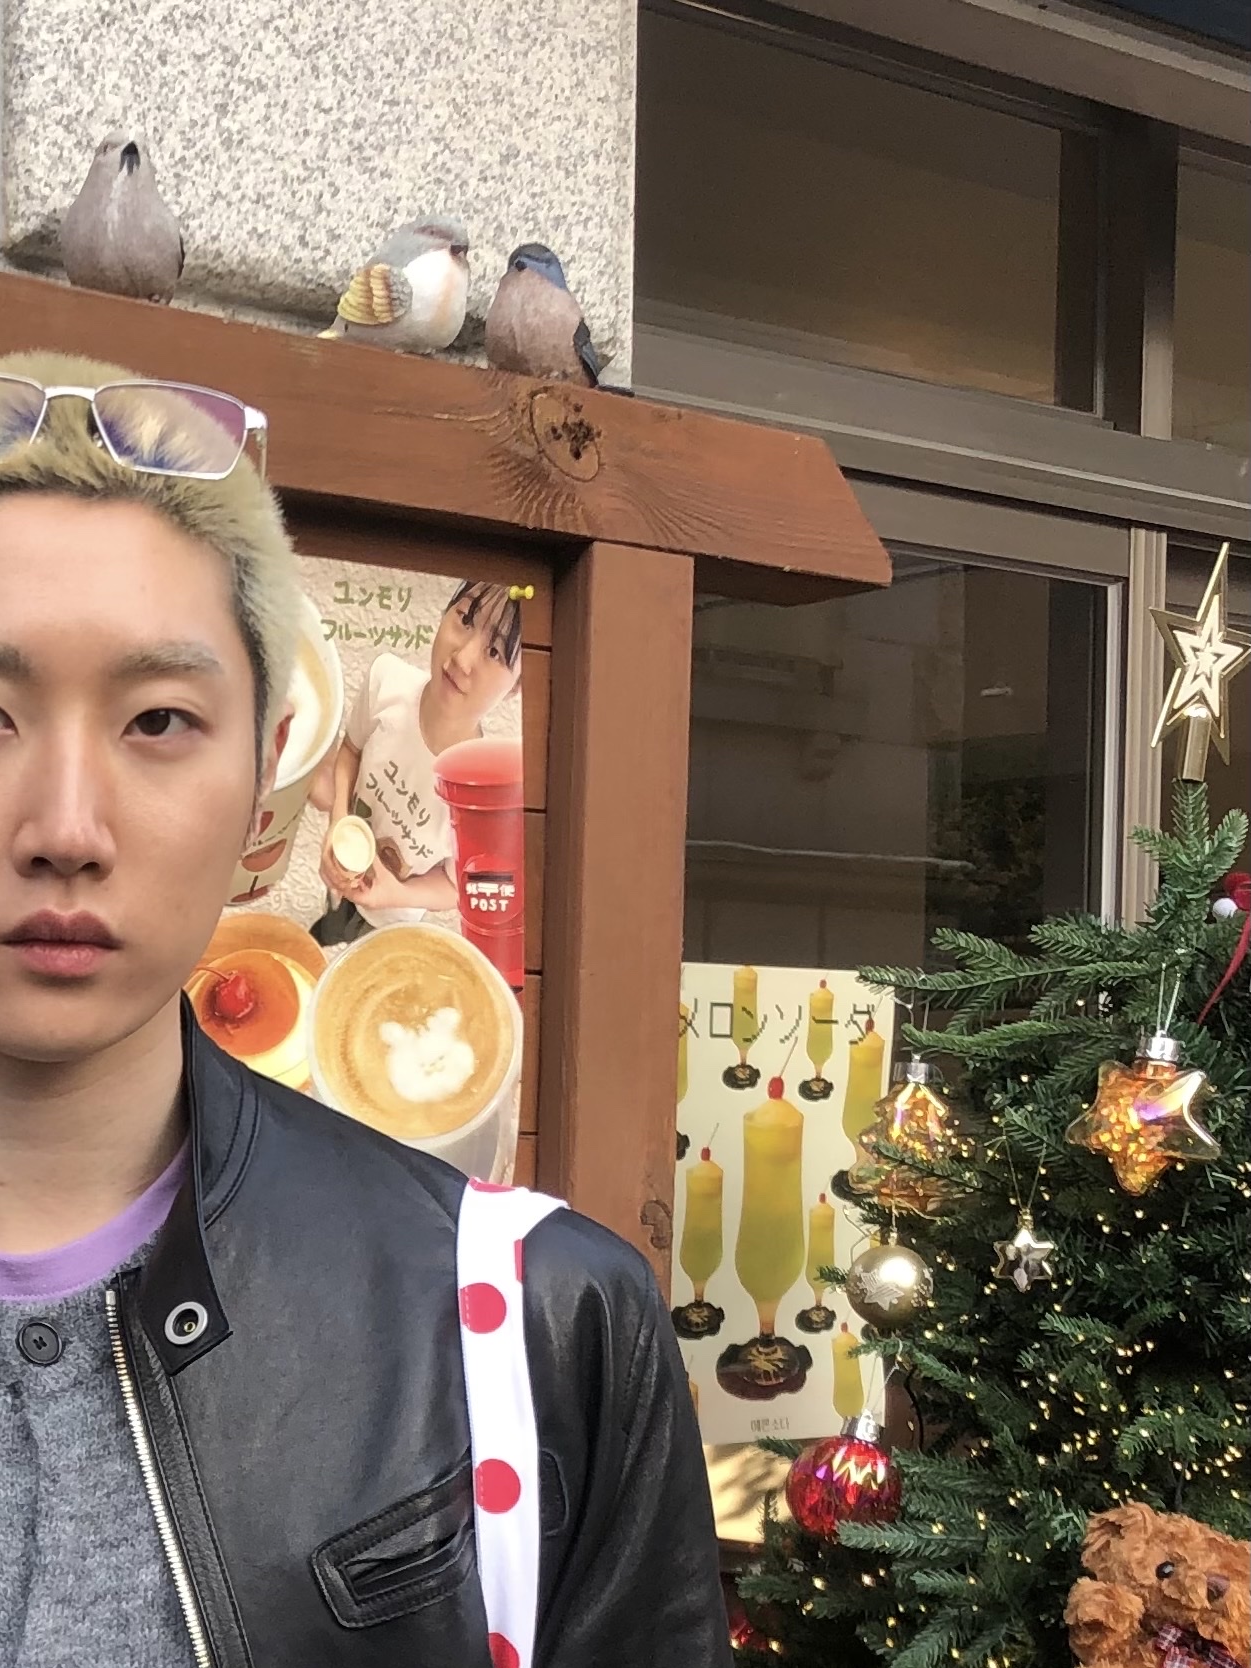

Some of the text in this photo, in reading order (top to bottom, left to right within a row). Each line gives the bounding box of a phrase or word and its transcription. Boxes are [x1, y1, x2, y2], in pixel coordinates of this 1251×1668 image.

[333, 581, 412, 612] ユンモリ
[320, 619, 434, 650] フルーツサンド
[383, 760, 431, 827] ユンモリ
[365, 772, 434, 859] フルーツサンド
[470, 897, 510, 912] POST
